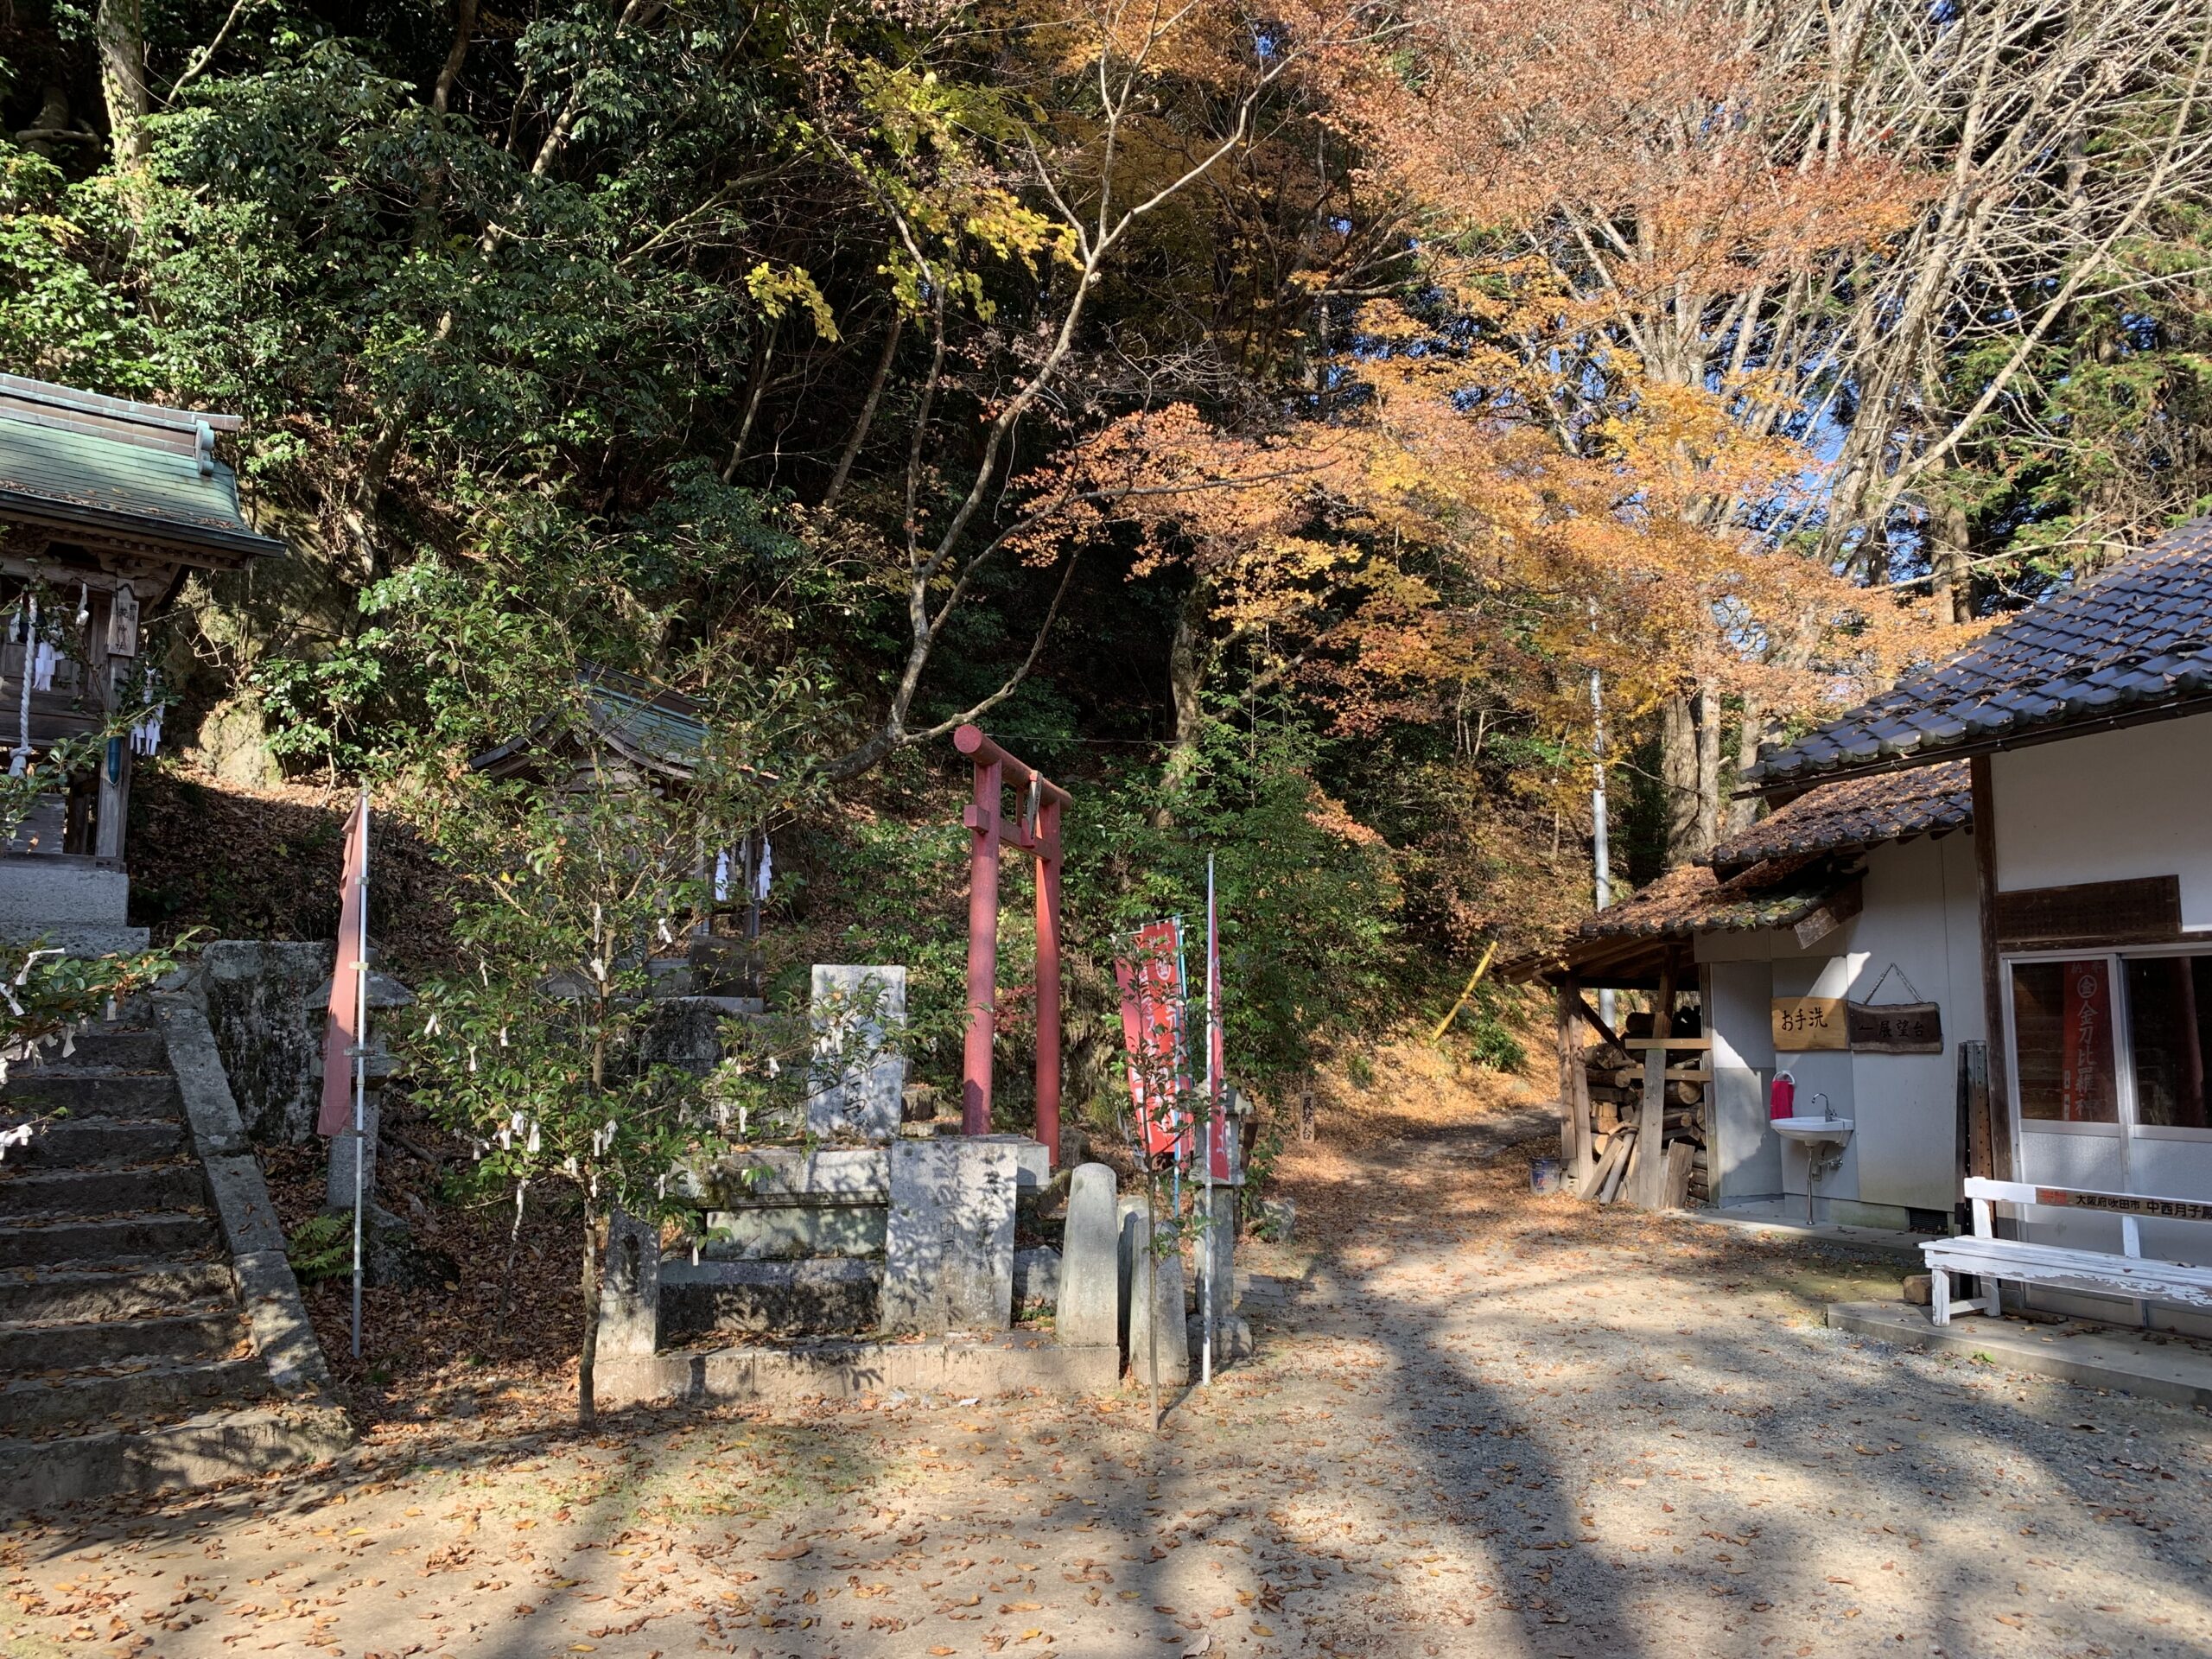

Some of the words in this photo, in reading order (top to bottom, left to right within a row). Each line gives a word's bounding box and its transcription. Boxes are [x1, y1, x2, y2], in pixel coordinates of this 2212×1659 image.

[1782, 1007, 1828, 1032] お手洗
[1878, 1019, 1925, 1038] 展望台
[2075, 1194, 2141, 1210] 大阪府吹田市
